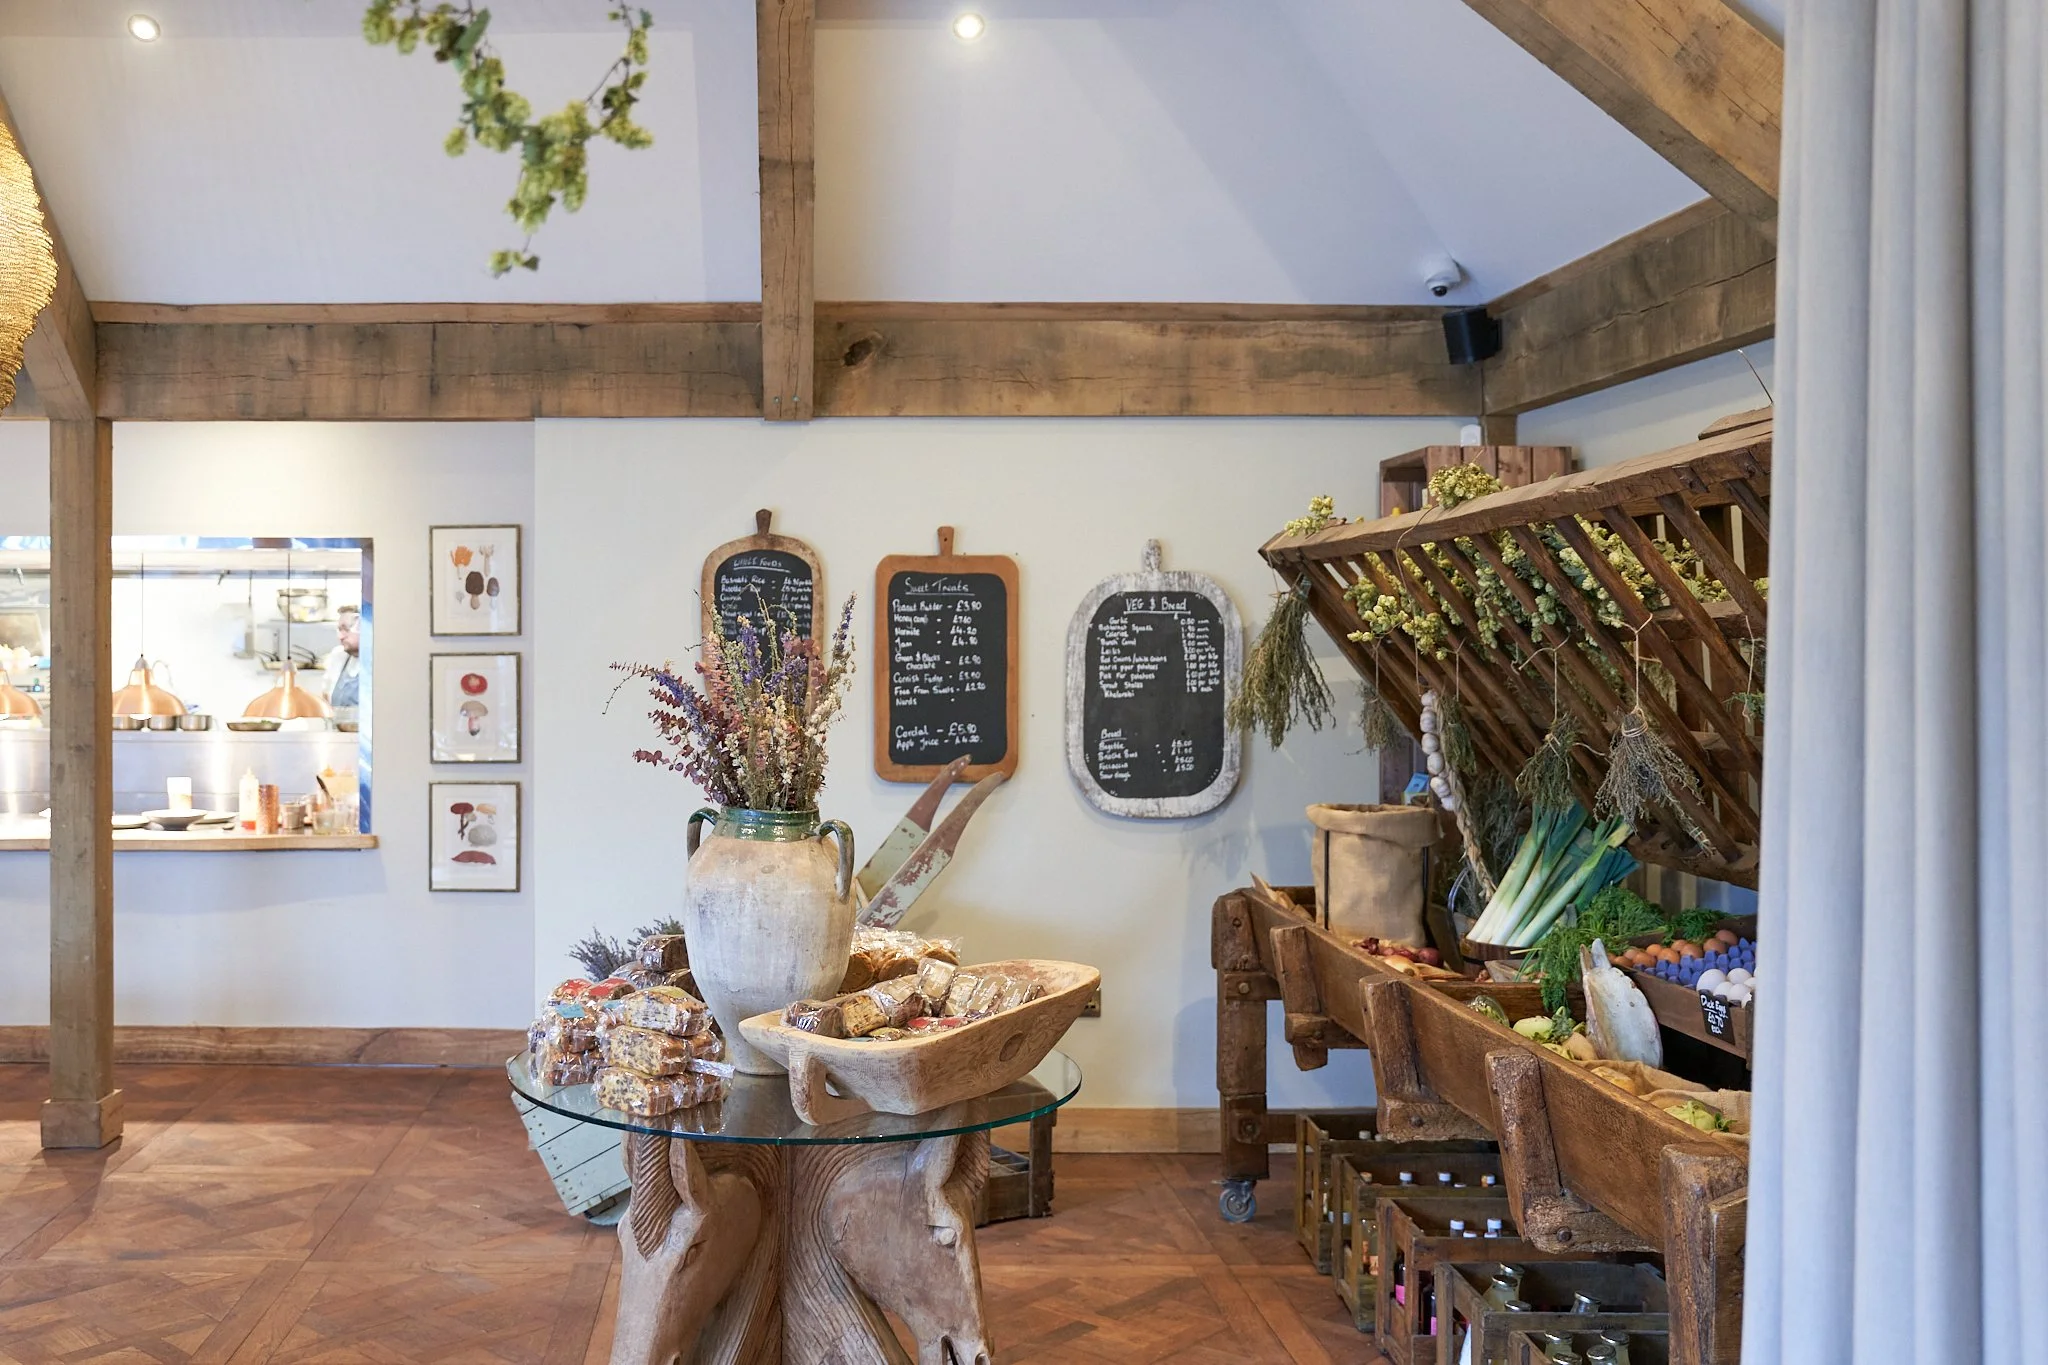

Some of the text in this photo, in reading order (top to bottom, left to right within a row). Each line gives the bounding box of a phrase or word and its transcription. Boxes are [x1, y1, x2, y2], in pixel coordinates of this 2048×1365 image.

[1125, 598, 1145, 611] VEG
[1161, 596, 1187, 610] Bread
[894, 637, 913, 653] Jam
